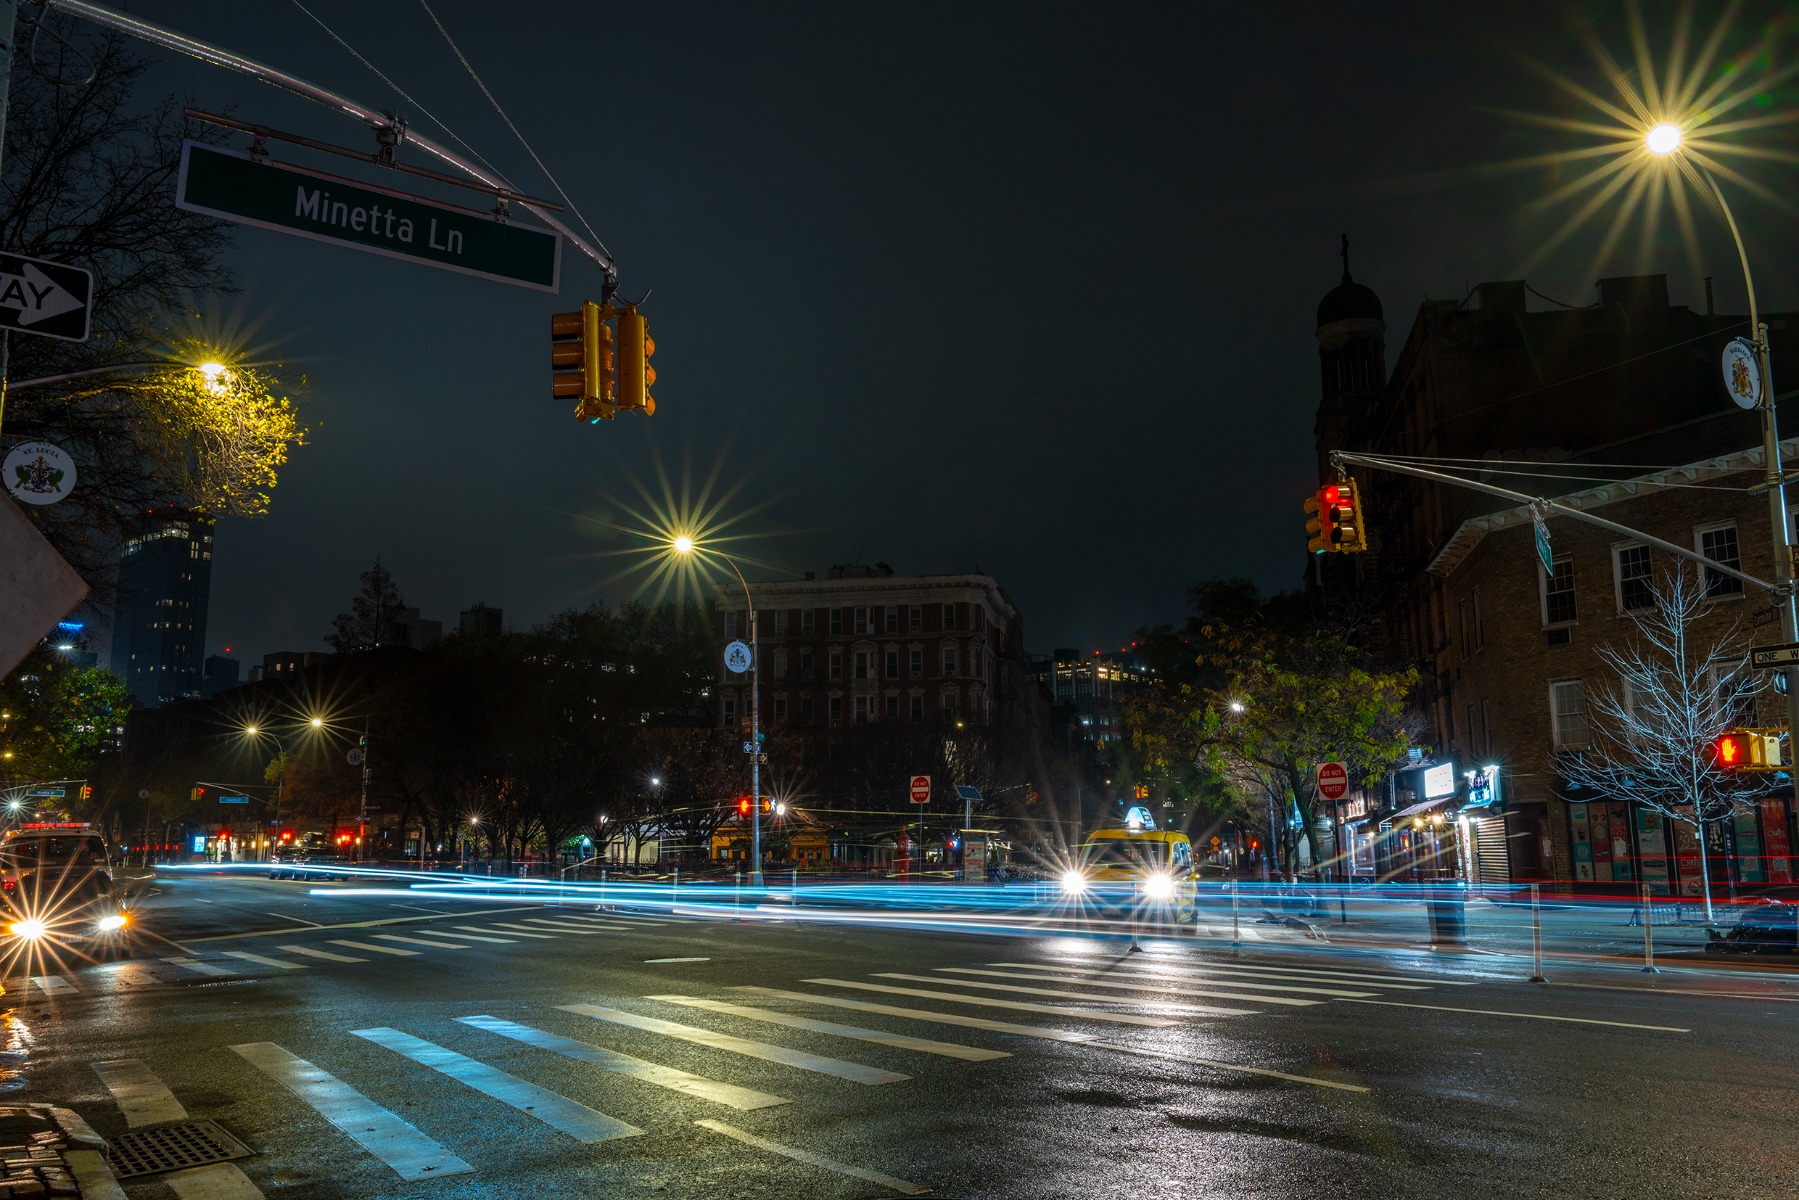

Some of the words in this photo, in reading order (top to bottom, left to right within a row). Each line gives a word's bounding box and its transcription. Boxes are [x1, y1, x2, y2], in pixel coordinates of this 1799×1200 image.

[295, 185, 414, 243] Minetta
[428, 218, 463, 254] Ln
[0, 277, 55, 310] AY
[36, 447, 59, 459] LUCIA
[1757, 652, 1778, 662] ONE
[1331, 769, 1342, 777] NOT
[1325, 785, 1342, 793] ENTER
